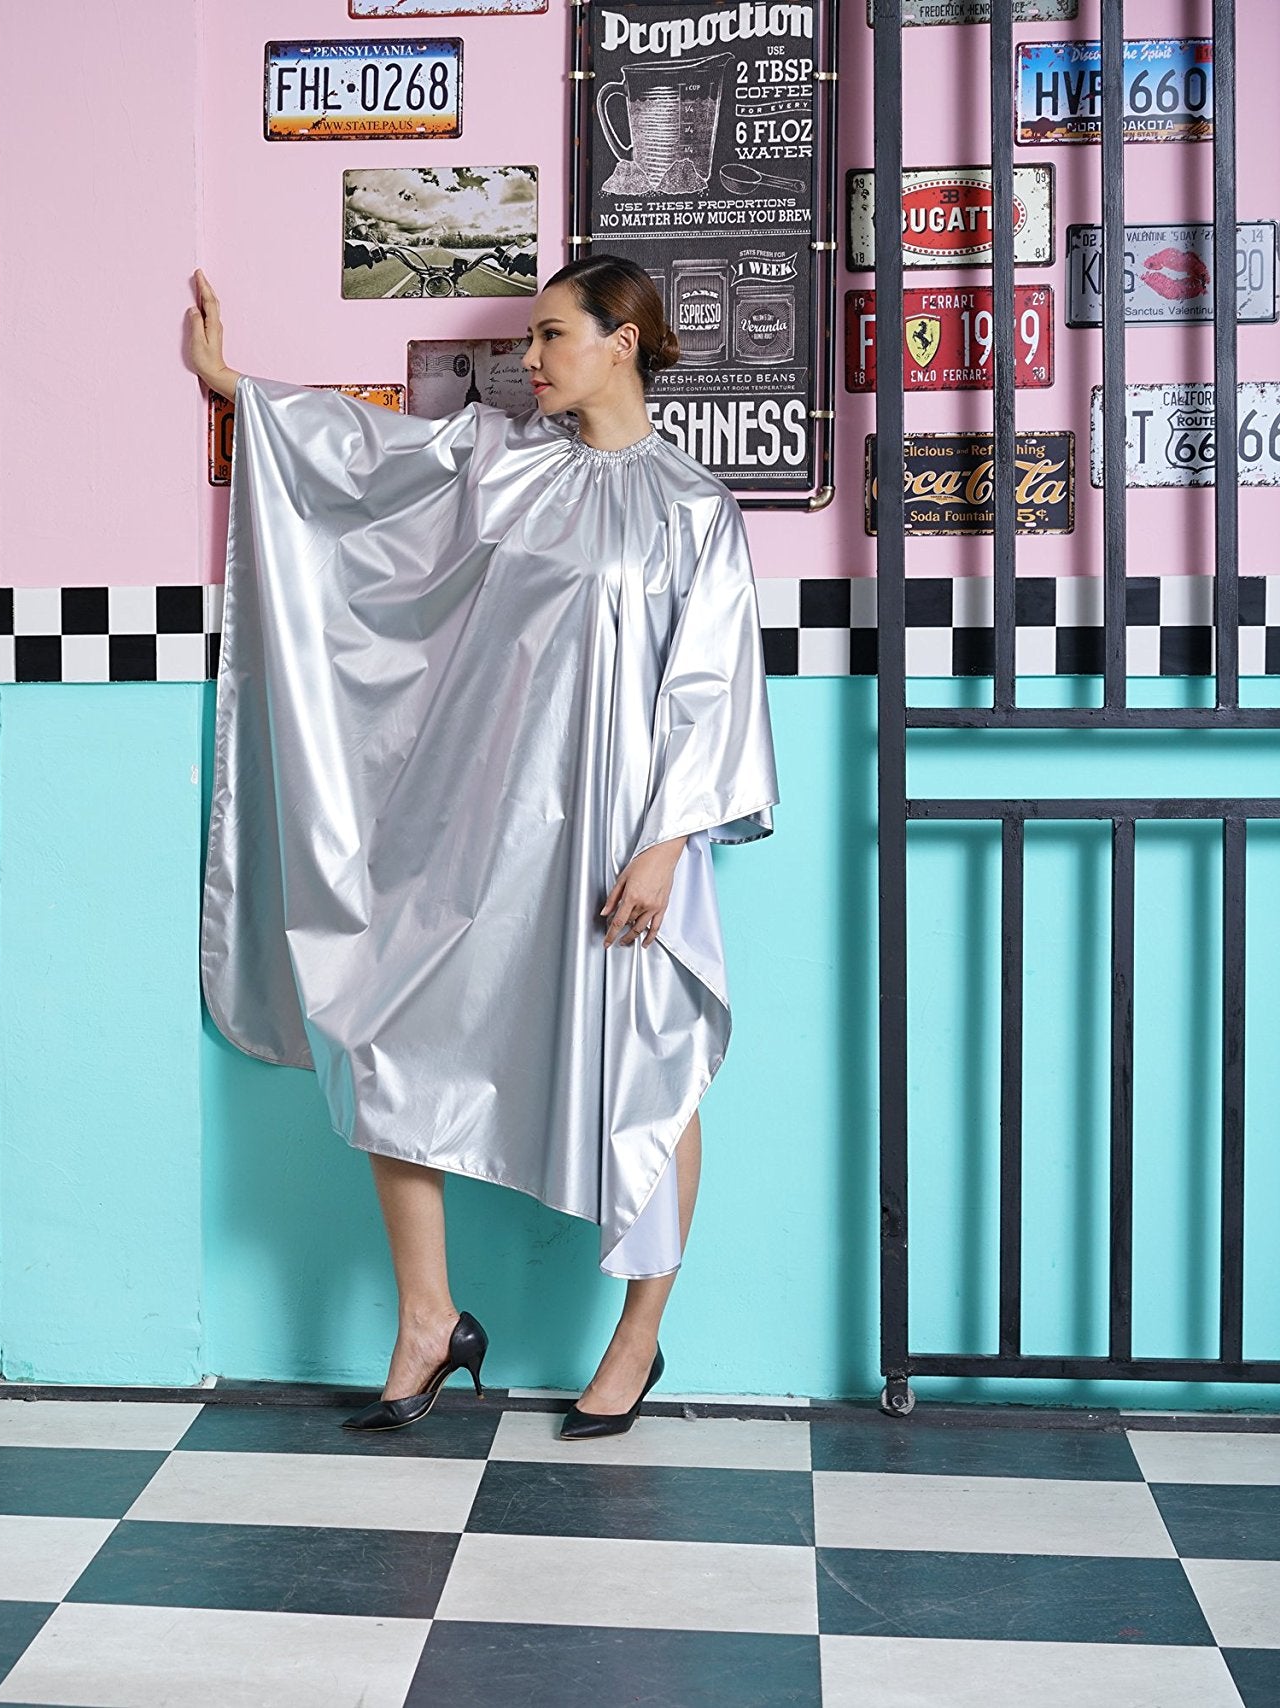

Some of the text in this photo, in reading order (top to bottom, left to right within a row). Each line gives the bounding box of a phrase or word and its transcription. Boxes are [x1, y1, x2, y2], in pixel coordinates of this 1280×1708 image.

[920, 4, 991, 17] FREDERICK HENR
[601, 2, 813, 57] Proportion
[313, 46, 414, 58] PENNSYLVANIA
[767, 46, 785, 55] USE
[1140, 45, 1172, 62] Spirit
[736, 59, 813, 84] 2 TBSP
[361, 62, 449, 111] 0268
[735, 85, 813, 99] COFFEE
[1129, 67, 1207, 114] 660
[770, 102, 808, 111] EVERY
[735, 121, 747, 144] 6
[734, 145, 813, 159] WATER
[1035, 172, 1046, 183] 09
[614, 199, 796, 212] USE THESE PROPORTIONS
[600, 208, 812, 227] NO MATTER HOW MUCH YOU BREW
[902, 206, 992, 232] UGATT
[1083, 234, 1096, 247] 02
[1251, 229, 1263, 242] 14
[856, 252, 865, 263] 18
[1035, 247, 1045, 259] 81
[738, 260, 793, 276] 1 WEEK
[1082, 252, 1135, 294] KIS
[681, 290, 719, 299] DARK
[1032, 292, 1045, 305] 29
[922, 294, 974, 310] FERRARI
[679, 303, 721, 324] ESPRESSO
[1125, 305, 1213, 316] Sanctus Valentinu
[740, 318, 788, 332] Veranda
[961, 309, 1040, 367] 199
[654, 373, 796, 385] FRESH-ROASTED BEANS
[910, 368, 987, 383] ENZO FERRARI
[1163, 390, 1216, 406] CALIFOR
[1177, 416, 1216, 427] ROUTE
[903, 445, 954, 457] elicious
[971, 444, 1046, 458] Refhing
[1174, 432, 1217, 463] 66
[872, 458, 1067, 505] oca-Cla
[910, 510, 940, 522] Soda
